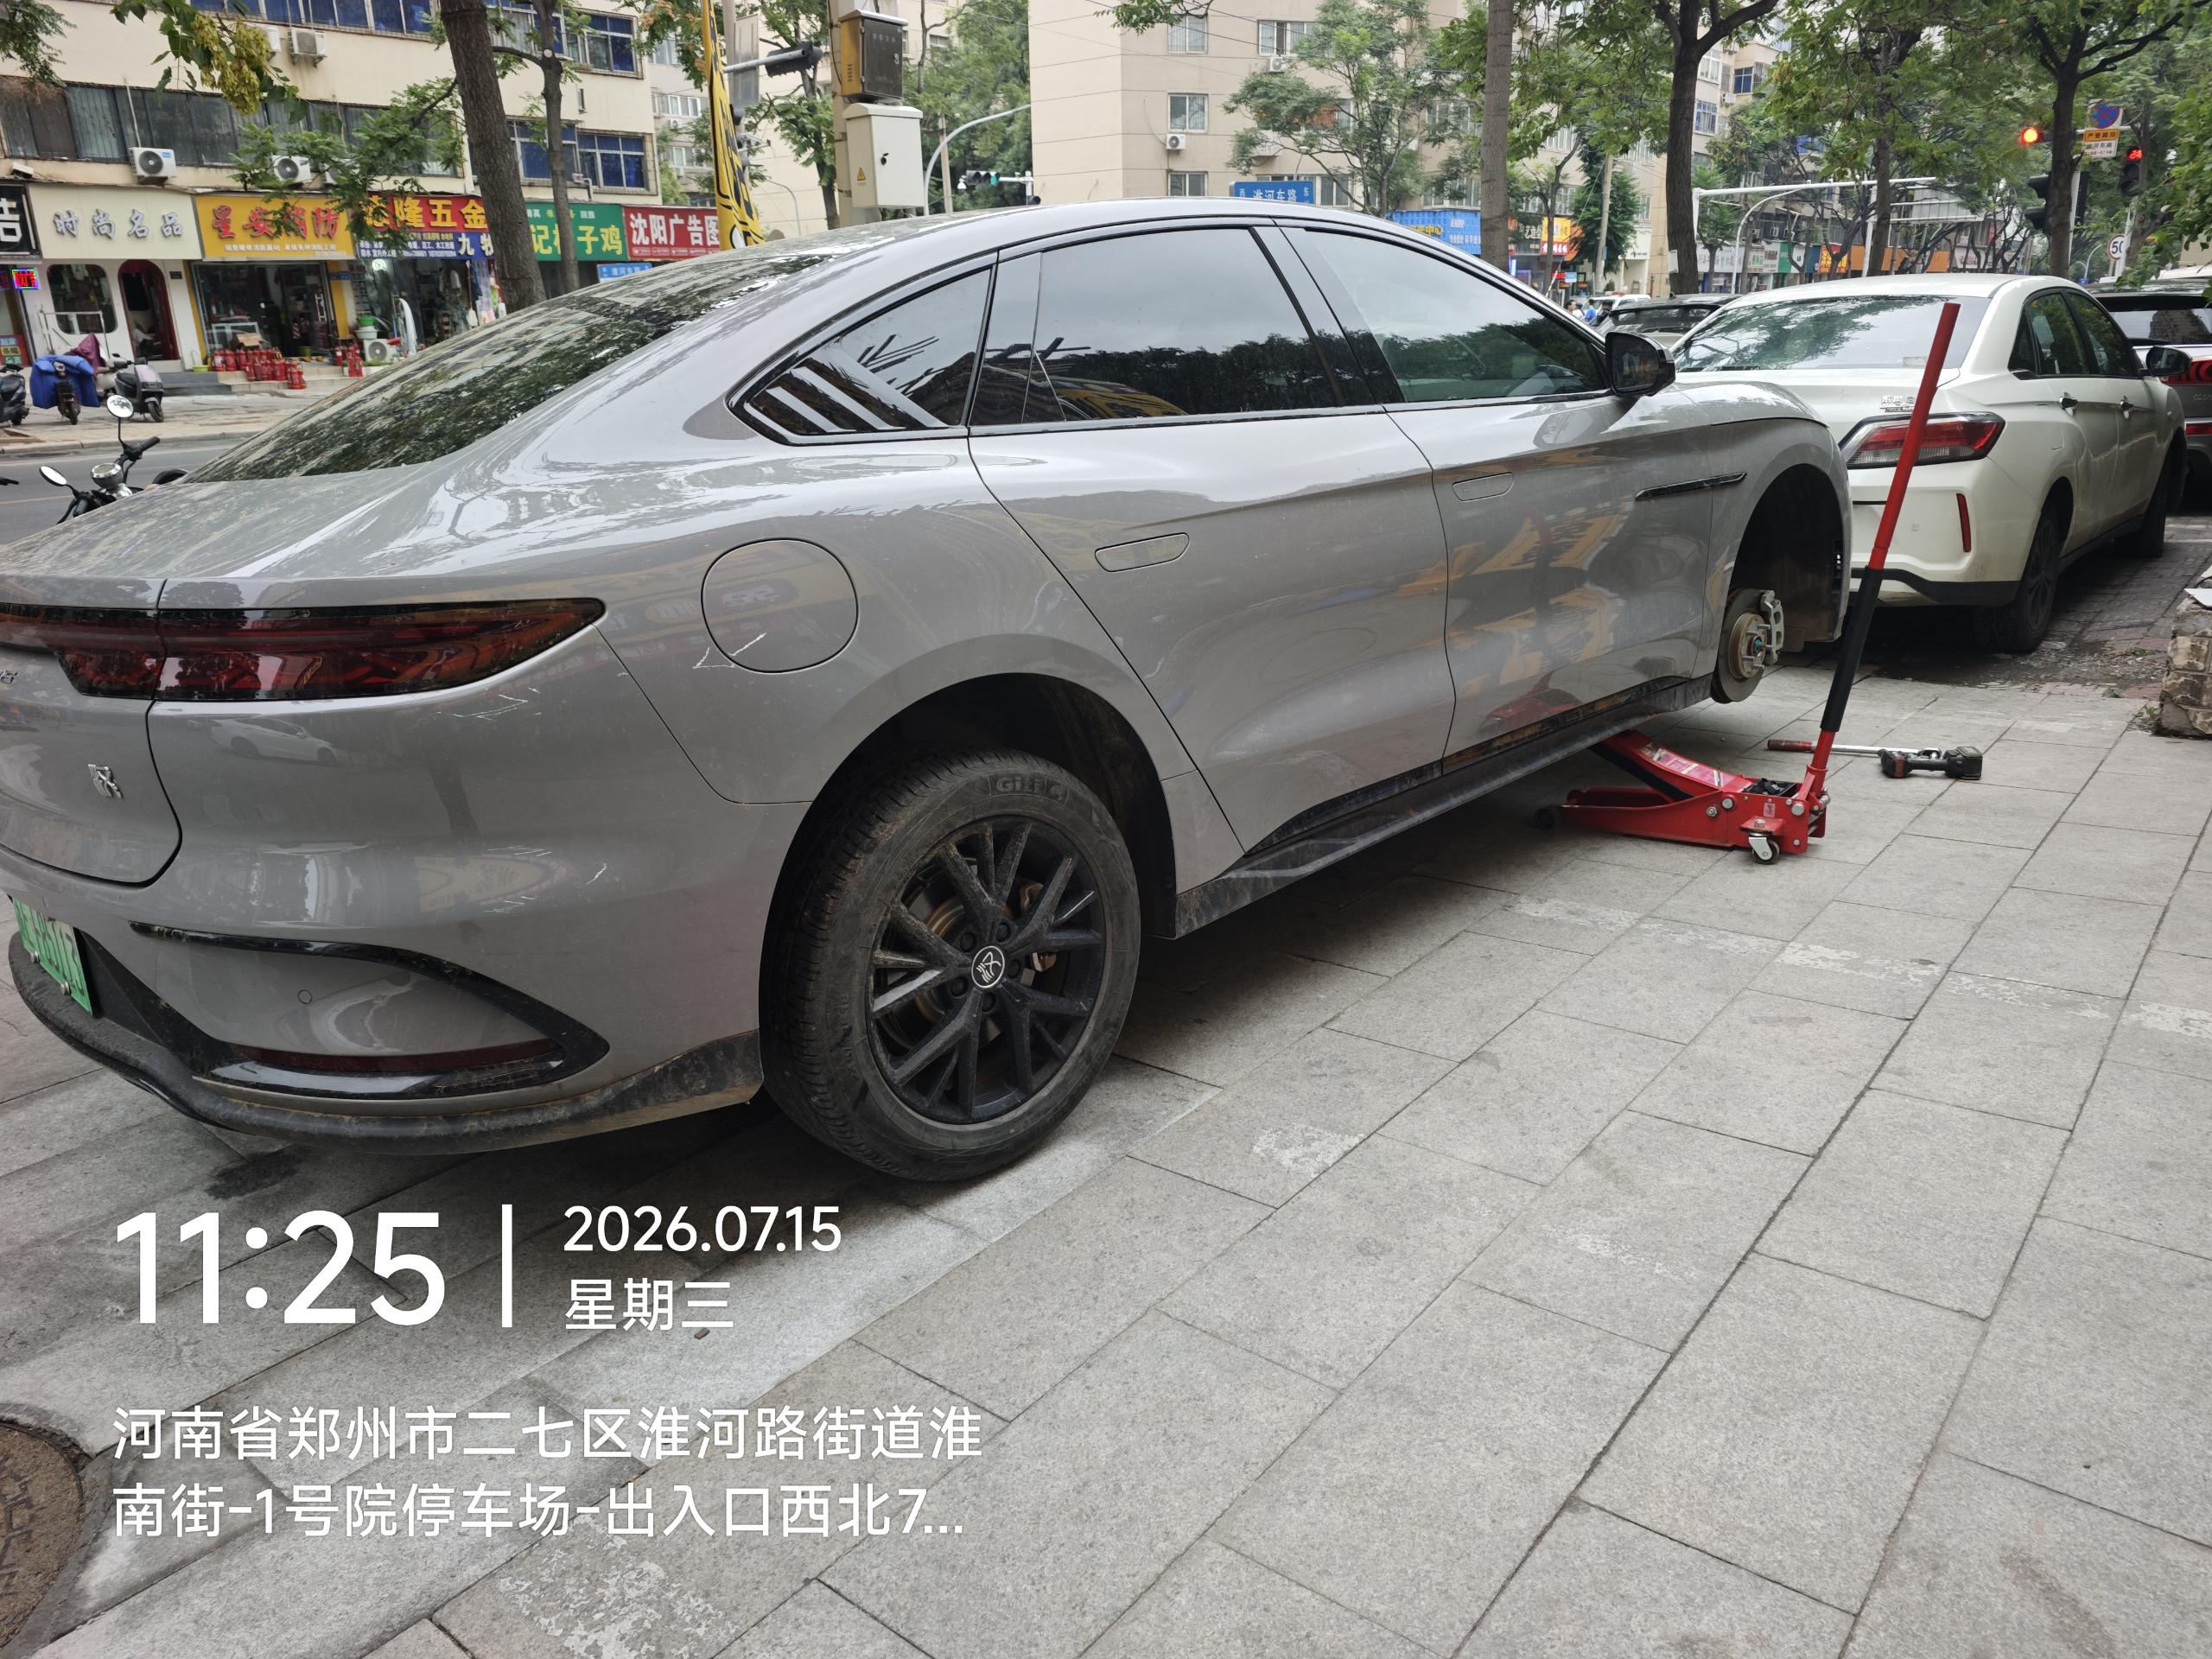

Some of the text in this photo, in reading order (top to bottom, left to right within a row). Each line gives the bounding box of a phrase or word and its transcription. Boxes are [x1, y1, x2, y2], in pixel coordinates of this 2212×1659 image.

[54, 208, 185, 238] 时尚名品
[629, 213, 720, 246] 沈阳广告图
